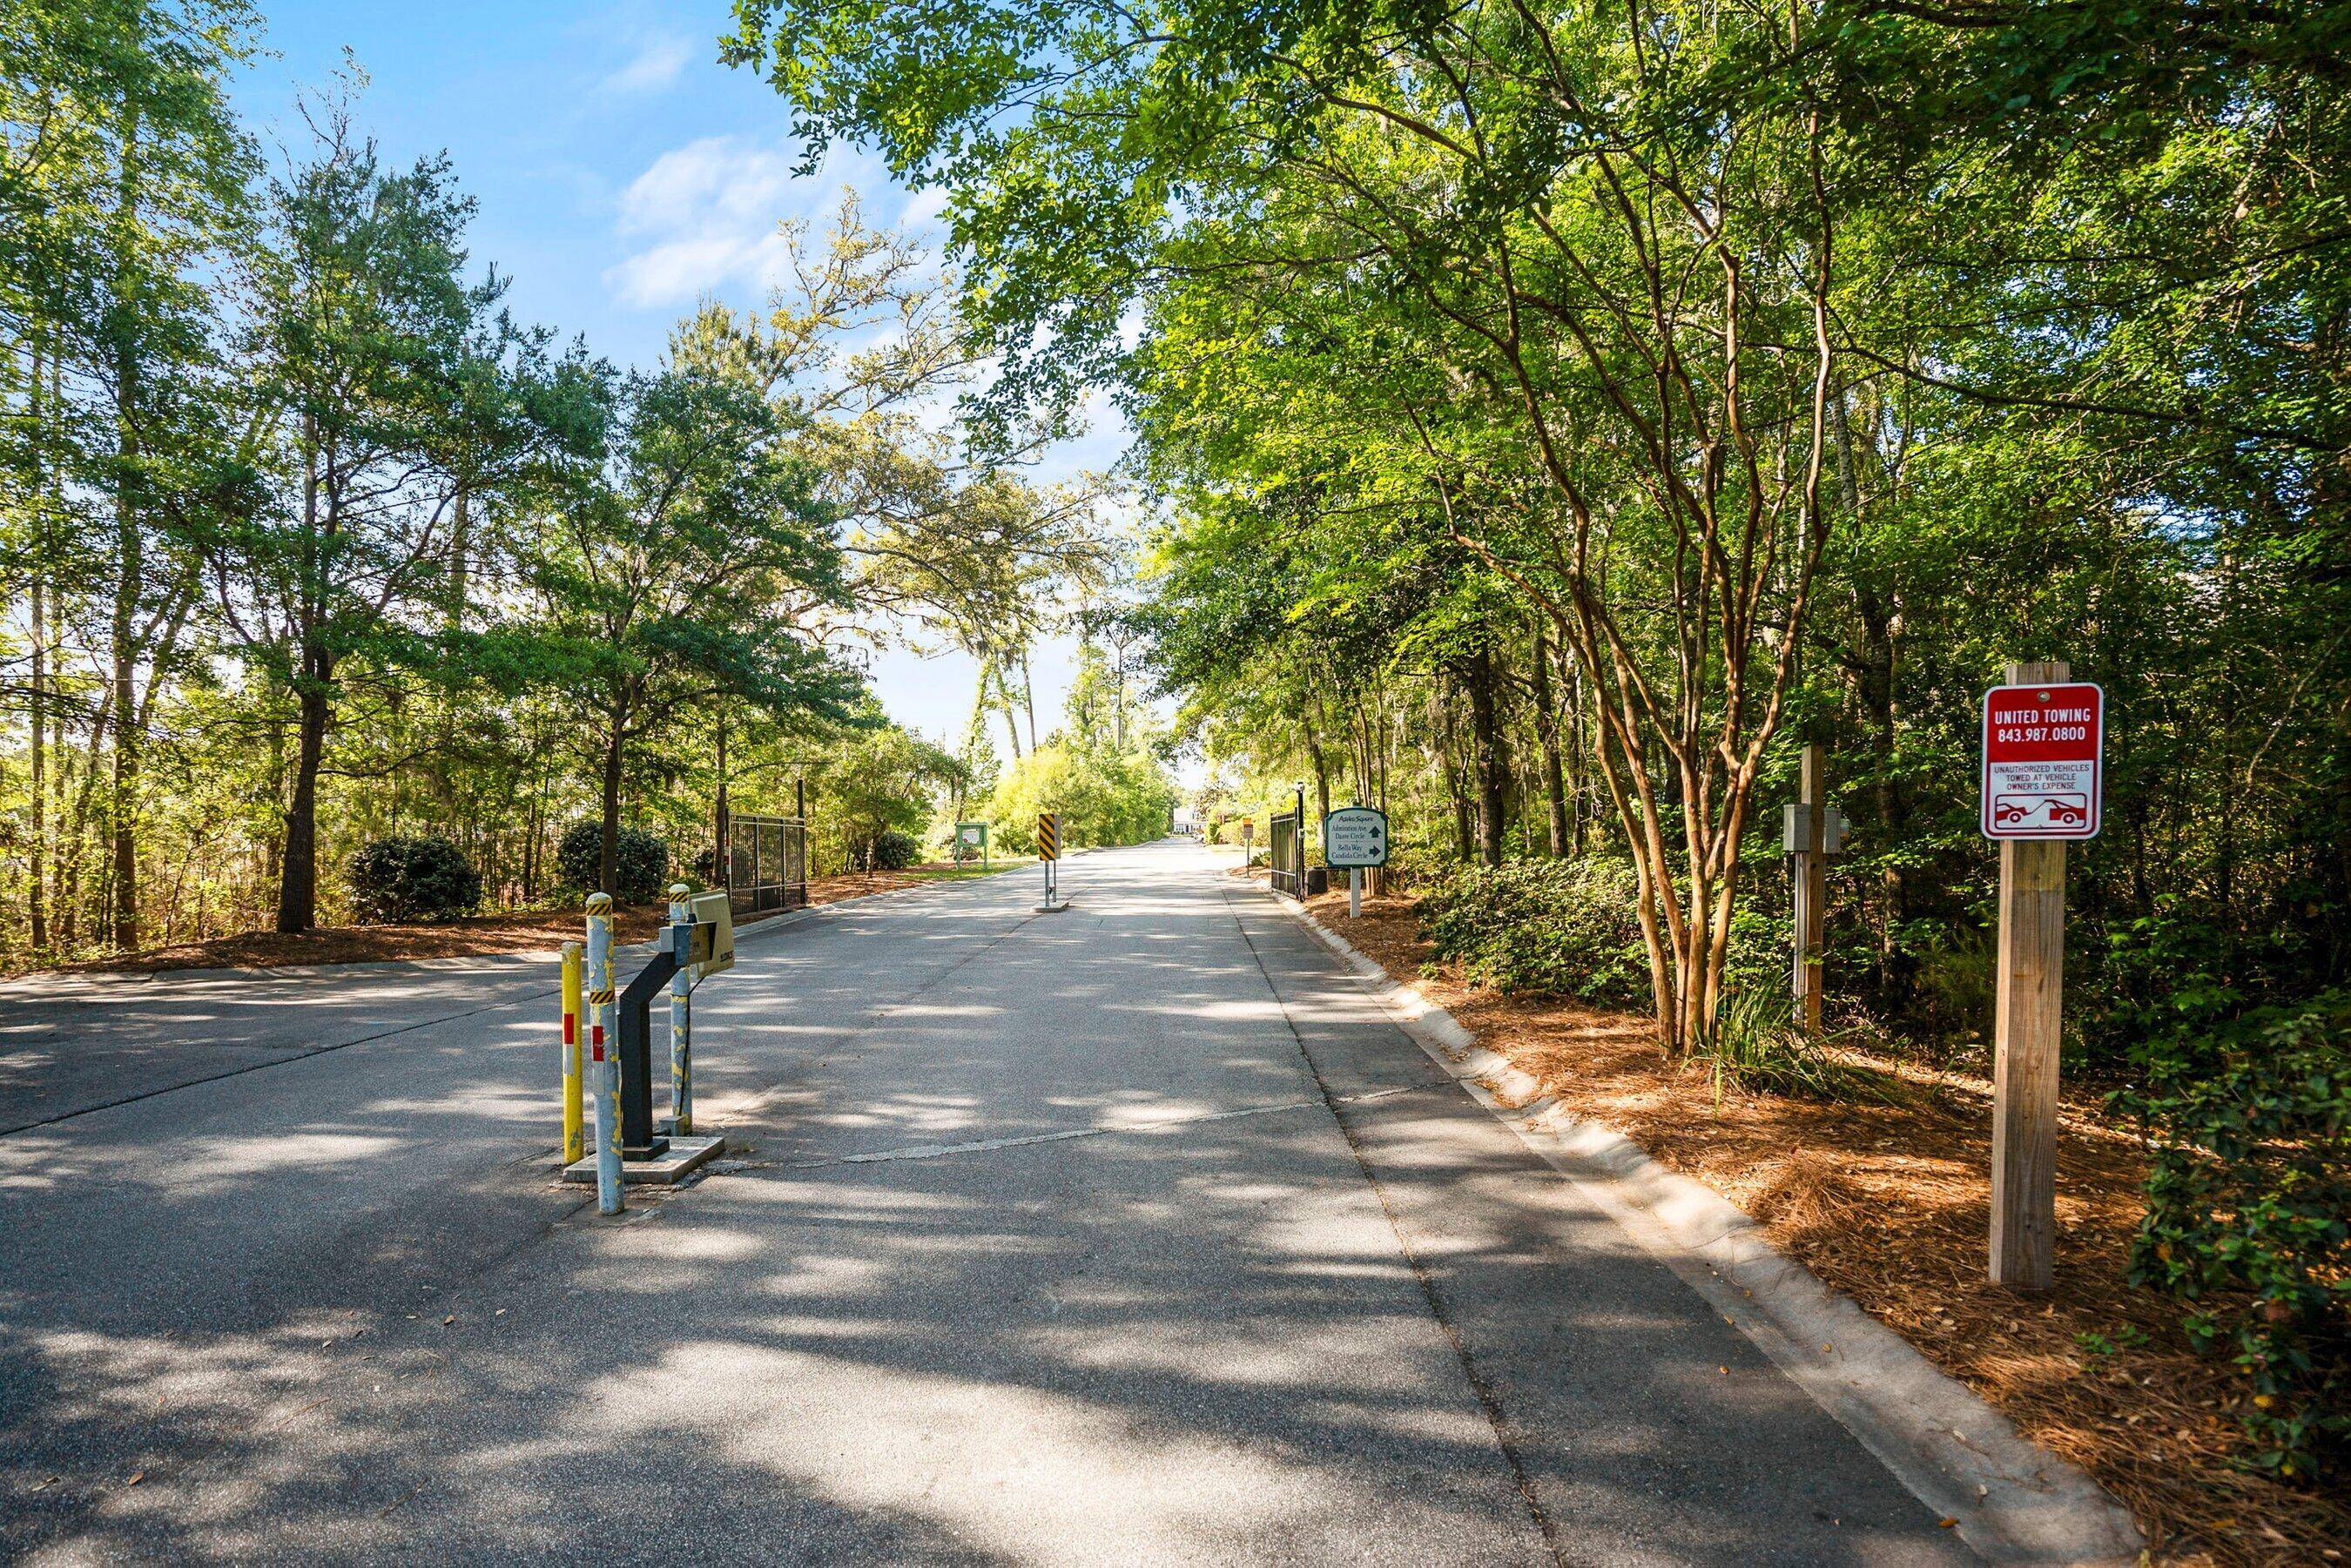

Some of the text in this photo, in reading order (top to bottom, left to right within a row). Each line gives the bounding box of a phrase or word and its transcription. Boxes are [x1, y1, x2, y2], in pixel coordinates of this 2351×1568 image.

[1994, 708, 2092, 724] UNITED TOWING
[1997, 726, 2085, 743] 843.987.0800
[1994, 764, 2090, 774] UNAUTHORIZED VEHICLES
[2006, 782, 2039, 791] OWNER'S
